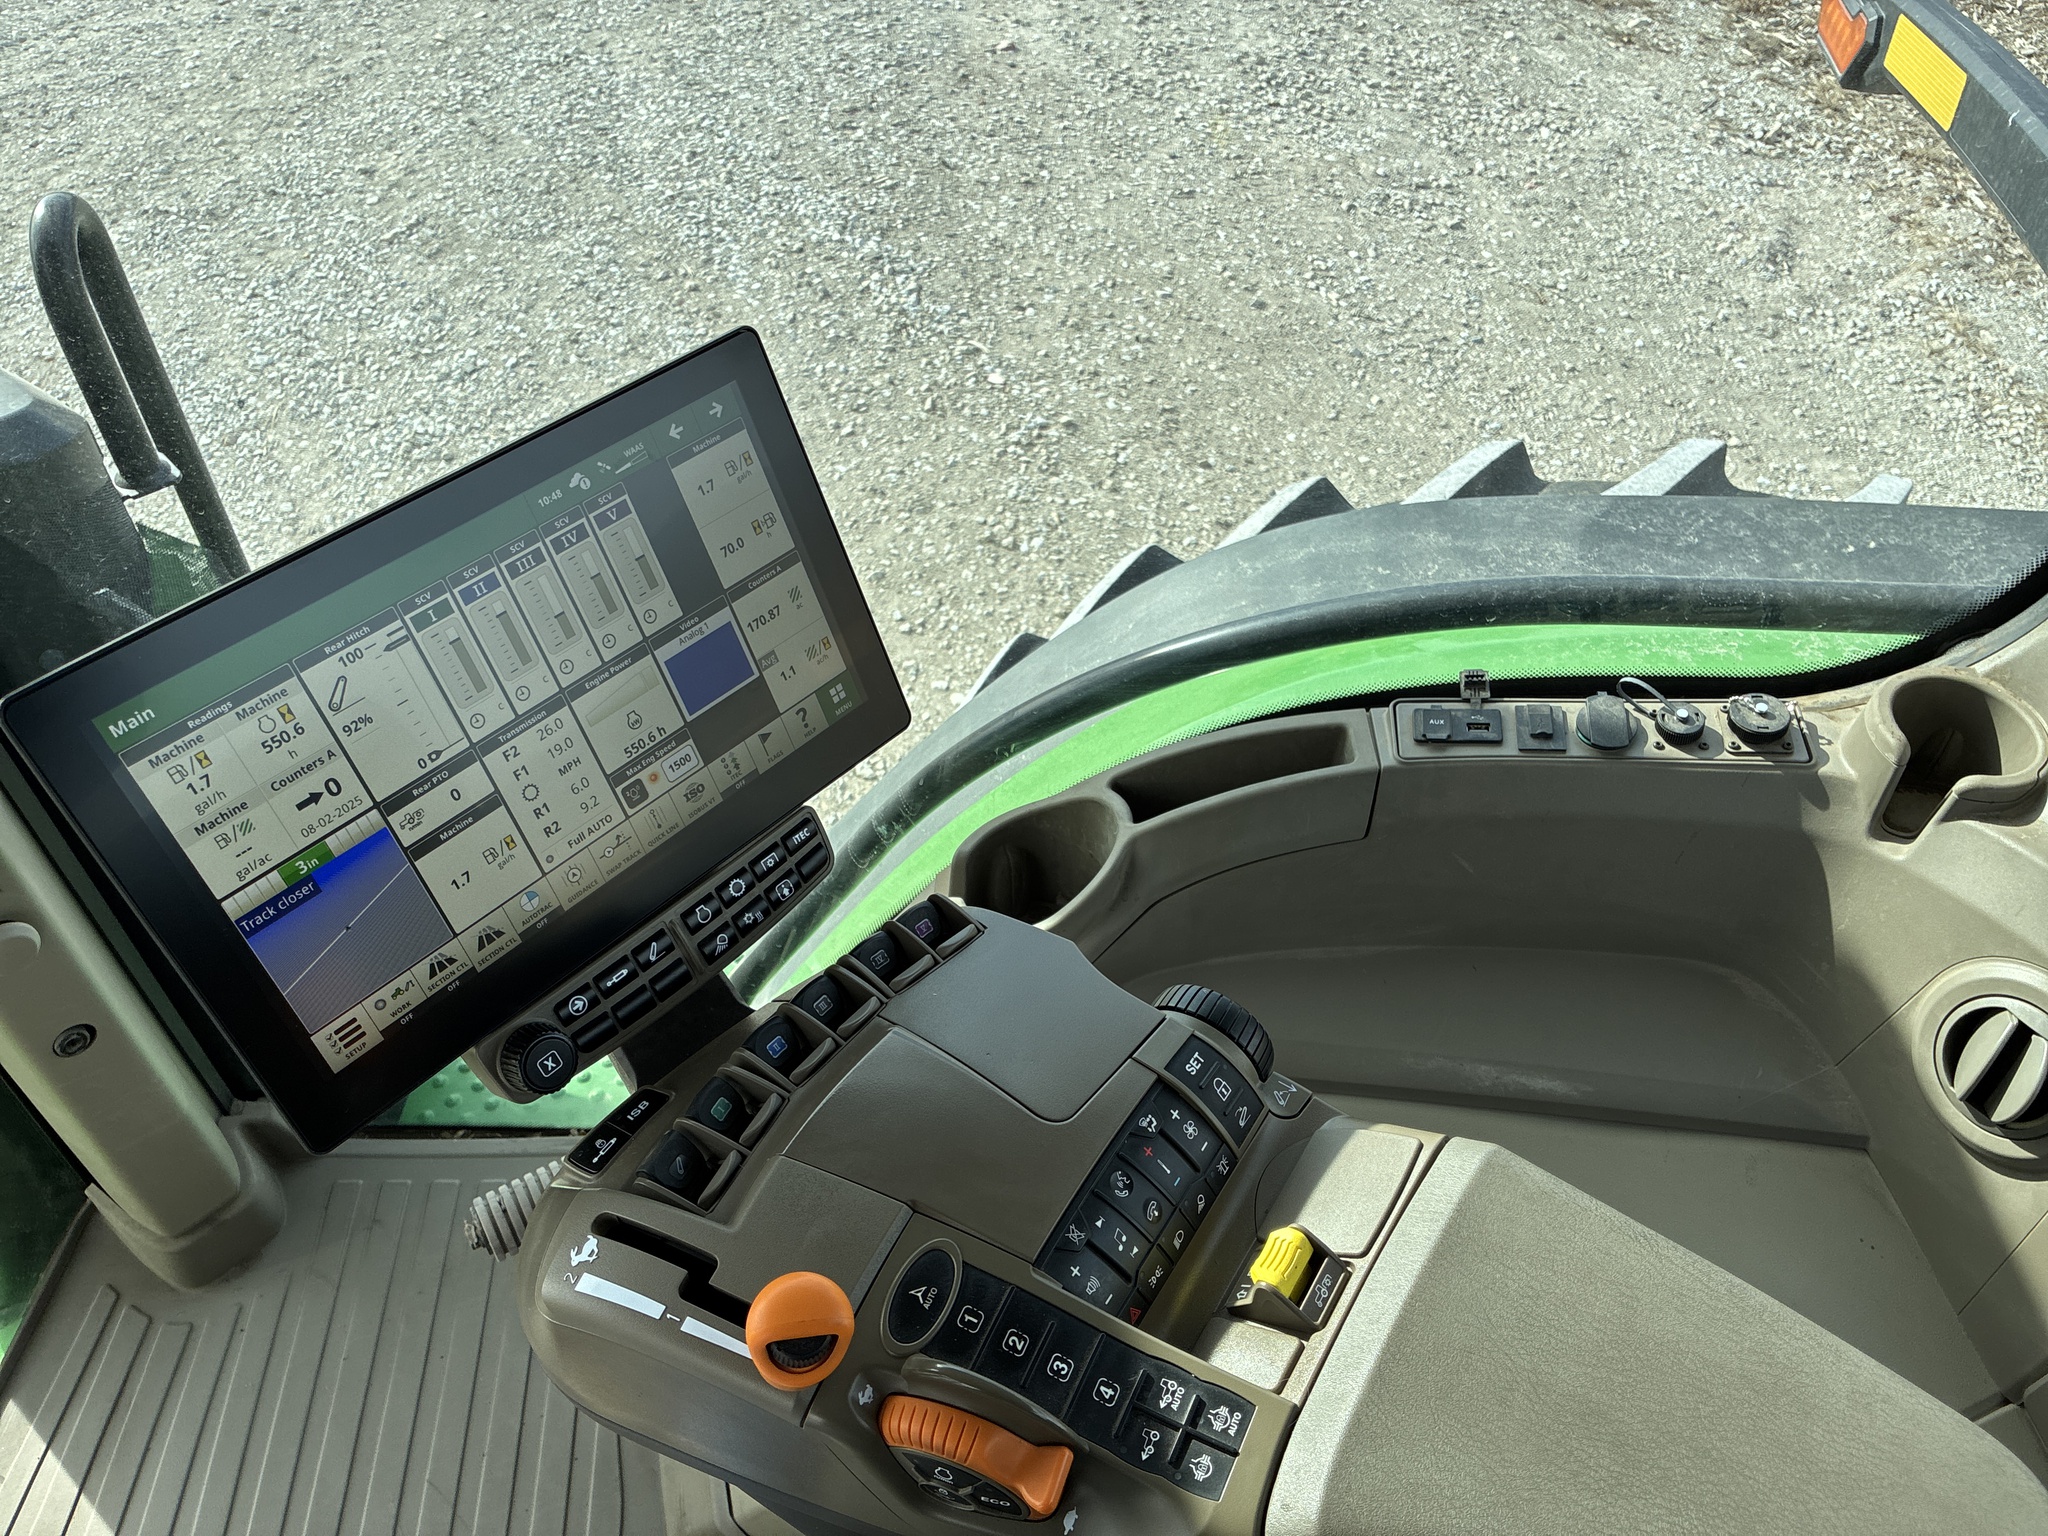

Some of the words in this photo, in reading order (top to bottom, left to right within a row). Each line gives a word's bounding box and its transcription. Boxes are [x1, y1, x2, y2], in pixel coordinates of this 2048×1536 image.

[623, 443, 644, 458] WAAS
[692, 434, 721, 453] Machine
[737, 470, 752, 484] gal/h
[698, 479, 714, 496] 1.7
[538, 489, 562, 507] 10:48
[598, 493, 612, 505] SCV
[555, 516, 569, 528] SCV
[606, 508, 616, 520] V
[510, 541, 524, 553] SCV
[561, 530, 576, 547] IV
[720, 537, 745, 558] 70.0
[463, 566, 479, 579] SCV
[516, 555, 536, 573] III
[748, 570, 776, 590] Counters
[415, 592, 431, 605] SCV
[472, 582, 488, 597] II
[796, 602, 803, 610] ac
[428, 609, 438, 622] I
[679, 616, 699, 631] Video
[747, 605, 781, 633] 170.87
[325, 638, 345, 655] Rear
[346, 626, 371, 642] Hitch
[679, 625, 704, 646] Analog
[338, 647, 364, 668] 100
[760, 654, 778, 669] Avg
[817, 654, 829, 666] ac/h
[585, 671, 610, 690] Engine
[610, 657, 632, 674] Power
[780, 665, 796, 681] 1.1
[235, 687, 289, 722] Machine
[835, 701, 853, 716] MENU
[108, 707, 156, 738] Main
[187, 701, 233, 729] Readings
[342, 713, 374, 737] 92%
[498, 710, 547, 743] Transmission
[804, 727, 817, 738] HELP
[261, 722, 305, 754] 550.6
[502, 746, 520, 762] F2
[536, 718, 564, 741] 26.0
[624, 732, 656, 758] 550.6
[657, 726, 667, 737] h
[148, 734, 205, 769] Machine
[288, 750, 298, 760] h
[513, 765, 530, 782] F1
[547, 737, 574, 759] 19.0
[626, 765, 642, 777] Max
[642, 754, 654, 766] Eng
[655, 741, 676, 758] Speed
[768, 750, 784, 764] FLAGS
[271, 755, 325, 792] Counters
[327, 749, 337, 760] A
[418, 758, 427, 769] 0
[558, 757, 581, 777] MPH
[668, 754, 692, 773] 1500
[187, 773, 212, 795] 1.7
[324, 778, 342, 796] 0
[412, 780, 431, 796] Rear
[432, 770, 449, 785] PTO
[571, 777, 590, 794] 6.0
[736, 779, 746, 789] OFF
[451, 789, 461, 801] 0
[683, 784, 705, 802] ISO
[195, 789, 227, 816] gal/h
[533, 802, 550, 819] R1
[580, 795, 600, 814] 9.2
[688, 802, 708, 818] ISOBUS
[194, 801, 249, 837] Machine
[301, 795, 363, 838] 08-02-2025
[440, 816, 474, 841] Machine
[543, 821, 562, 838] R2
[567, 833, 586, 848] Full
[588, 814, 613, 836] AUTO
[647, 833, 665, 847] QUICK
[665, 822, 680, 837] LINE
[236, 852, 273, 881] gal/ac
[498, 854, 516, 870] gal/h
[606, 862, 622, 876] SWAP
[622, 849, 642, 867] TRACK
[451, 871, 471, 890] 1.7
[567, 879, 599, 904] GUIDANCE
[240, 904, 277, 932] Track
[279, 881, 314, 910] closer
[521, 901, 553, 927] AUTOTRAC
[536, 918, 548, 929] OFF
[477, 945, 505, 967] SECTION
[505, 937, 518, 949] CTL
[427, 969, 456, 993] SECTION
[456, 961, 469, 973] CTL
[448, 980, 461, 992] OFF
[390, 1001, 412, 1018] WORK
[400, 1013, 414, 1025] OFF
[345, 1042, 367, 1060] SETUP
[1185, 1052, 1205, 1075] SET
[627, 1100, 649, 1121] ISB
[564, 1272, 578, 1284] 2
[923, 1287, 938, 1310] AUTO
[964, 1312, 978, 1324] 1
[1008, 1336, 1024, 1350] 2
[1054, 1360, 1068, 1375] 3
[1100, 1386, 1115, 1399] 4
[1170, 1386, 1185, 1411] AUTO
[1228, 1412, 1242, 1437] AUTO
[981, 1497, 1010, 1506] ECO
